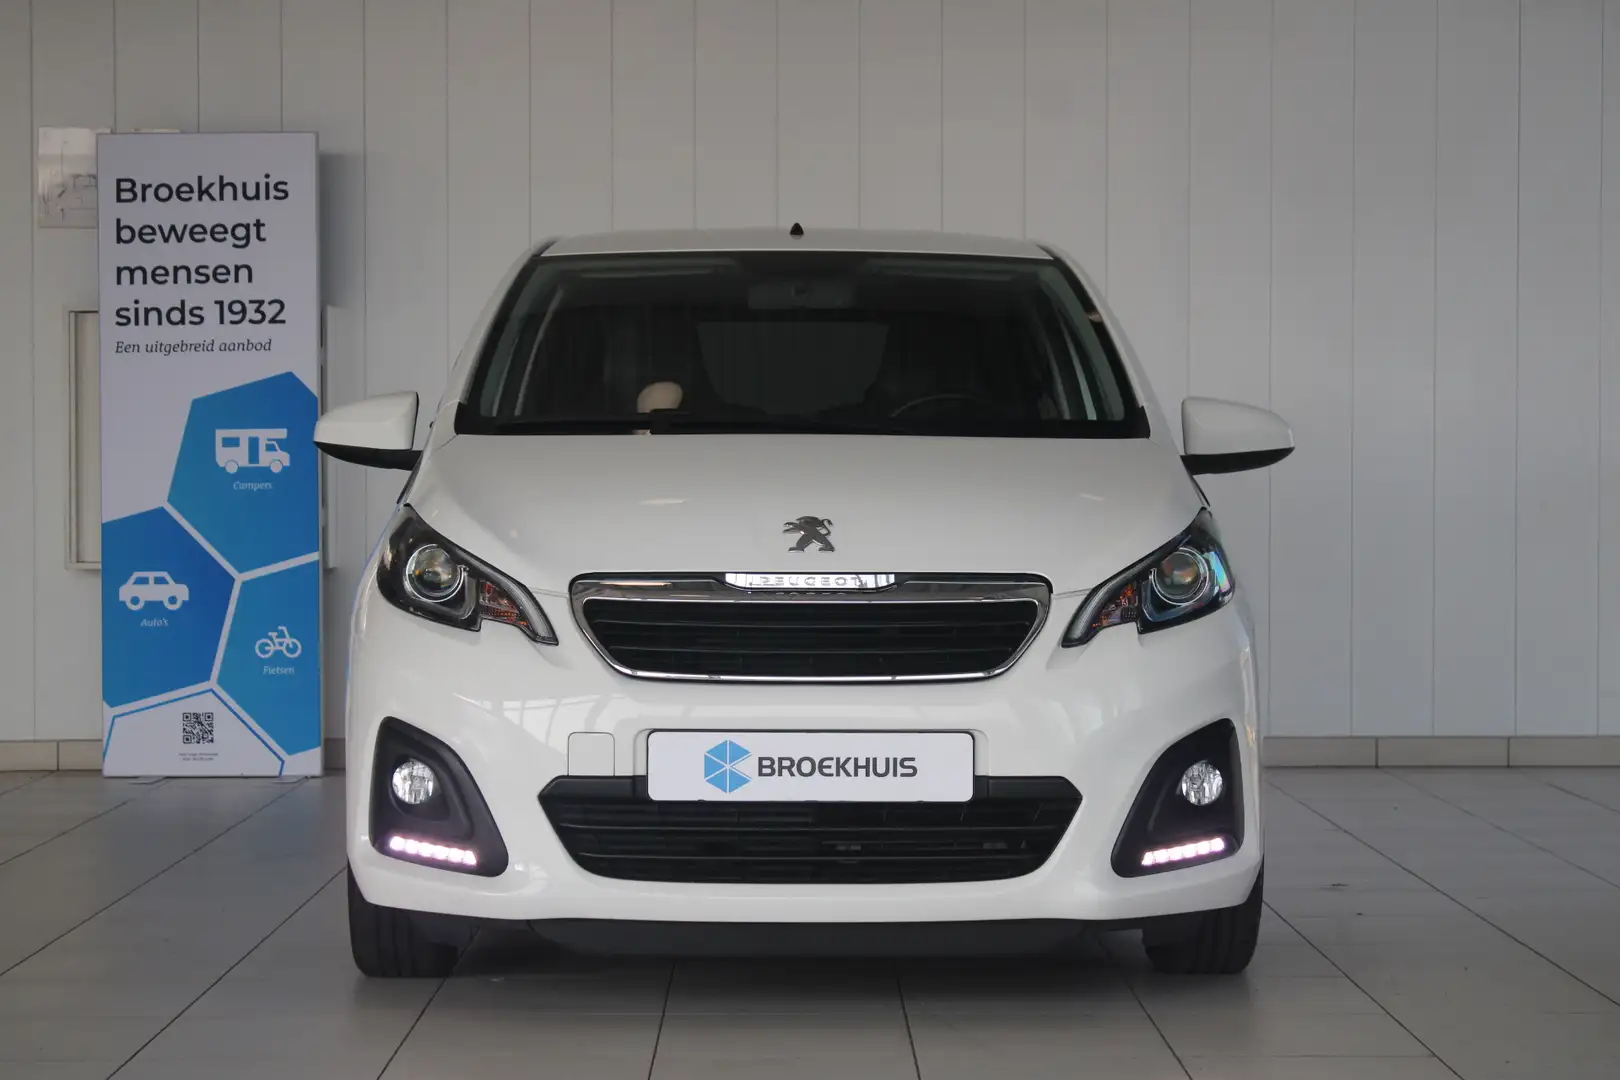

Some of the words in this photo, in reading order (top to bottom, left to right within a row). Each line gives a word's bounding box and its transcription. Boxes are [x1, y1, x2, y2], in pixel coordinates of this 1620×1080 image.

[115, 173, 289, 203] Broekhuis
[115, 217, 267, 249] beweegt
[116, 264, 253, 285] mensen
[115, 299, 205, 326] sinds
[214, 299, 286, 325] 1932
[115, 341, 140, 354] Een
[145, 339, 215, 356] uitgebreid
[218, 338, 272, 352] aanbod
[233, 480, 273, 491] Campers
[759, 576, 862, 587] PEUGEOT
[140, 618, 168, 627] Auto's
[263, 665, 295, 675] Fietsen
[757, 757, 918, 778] BROEKHUIS
